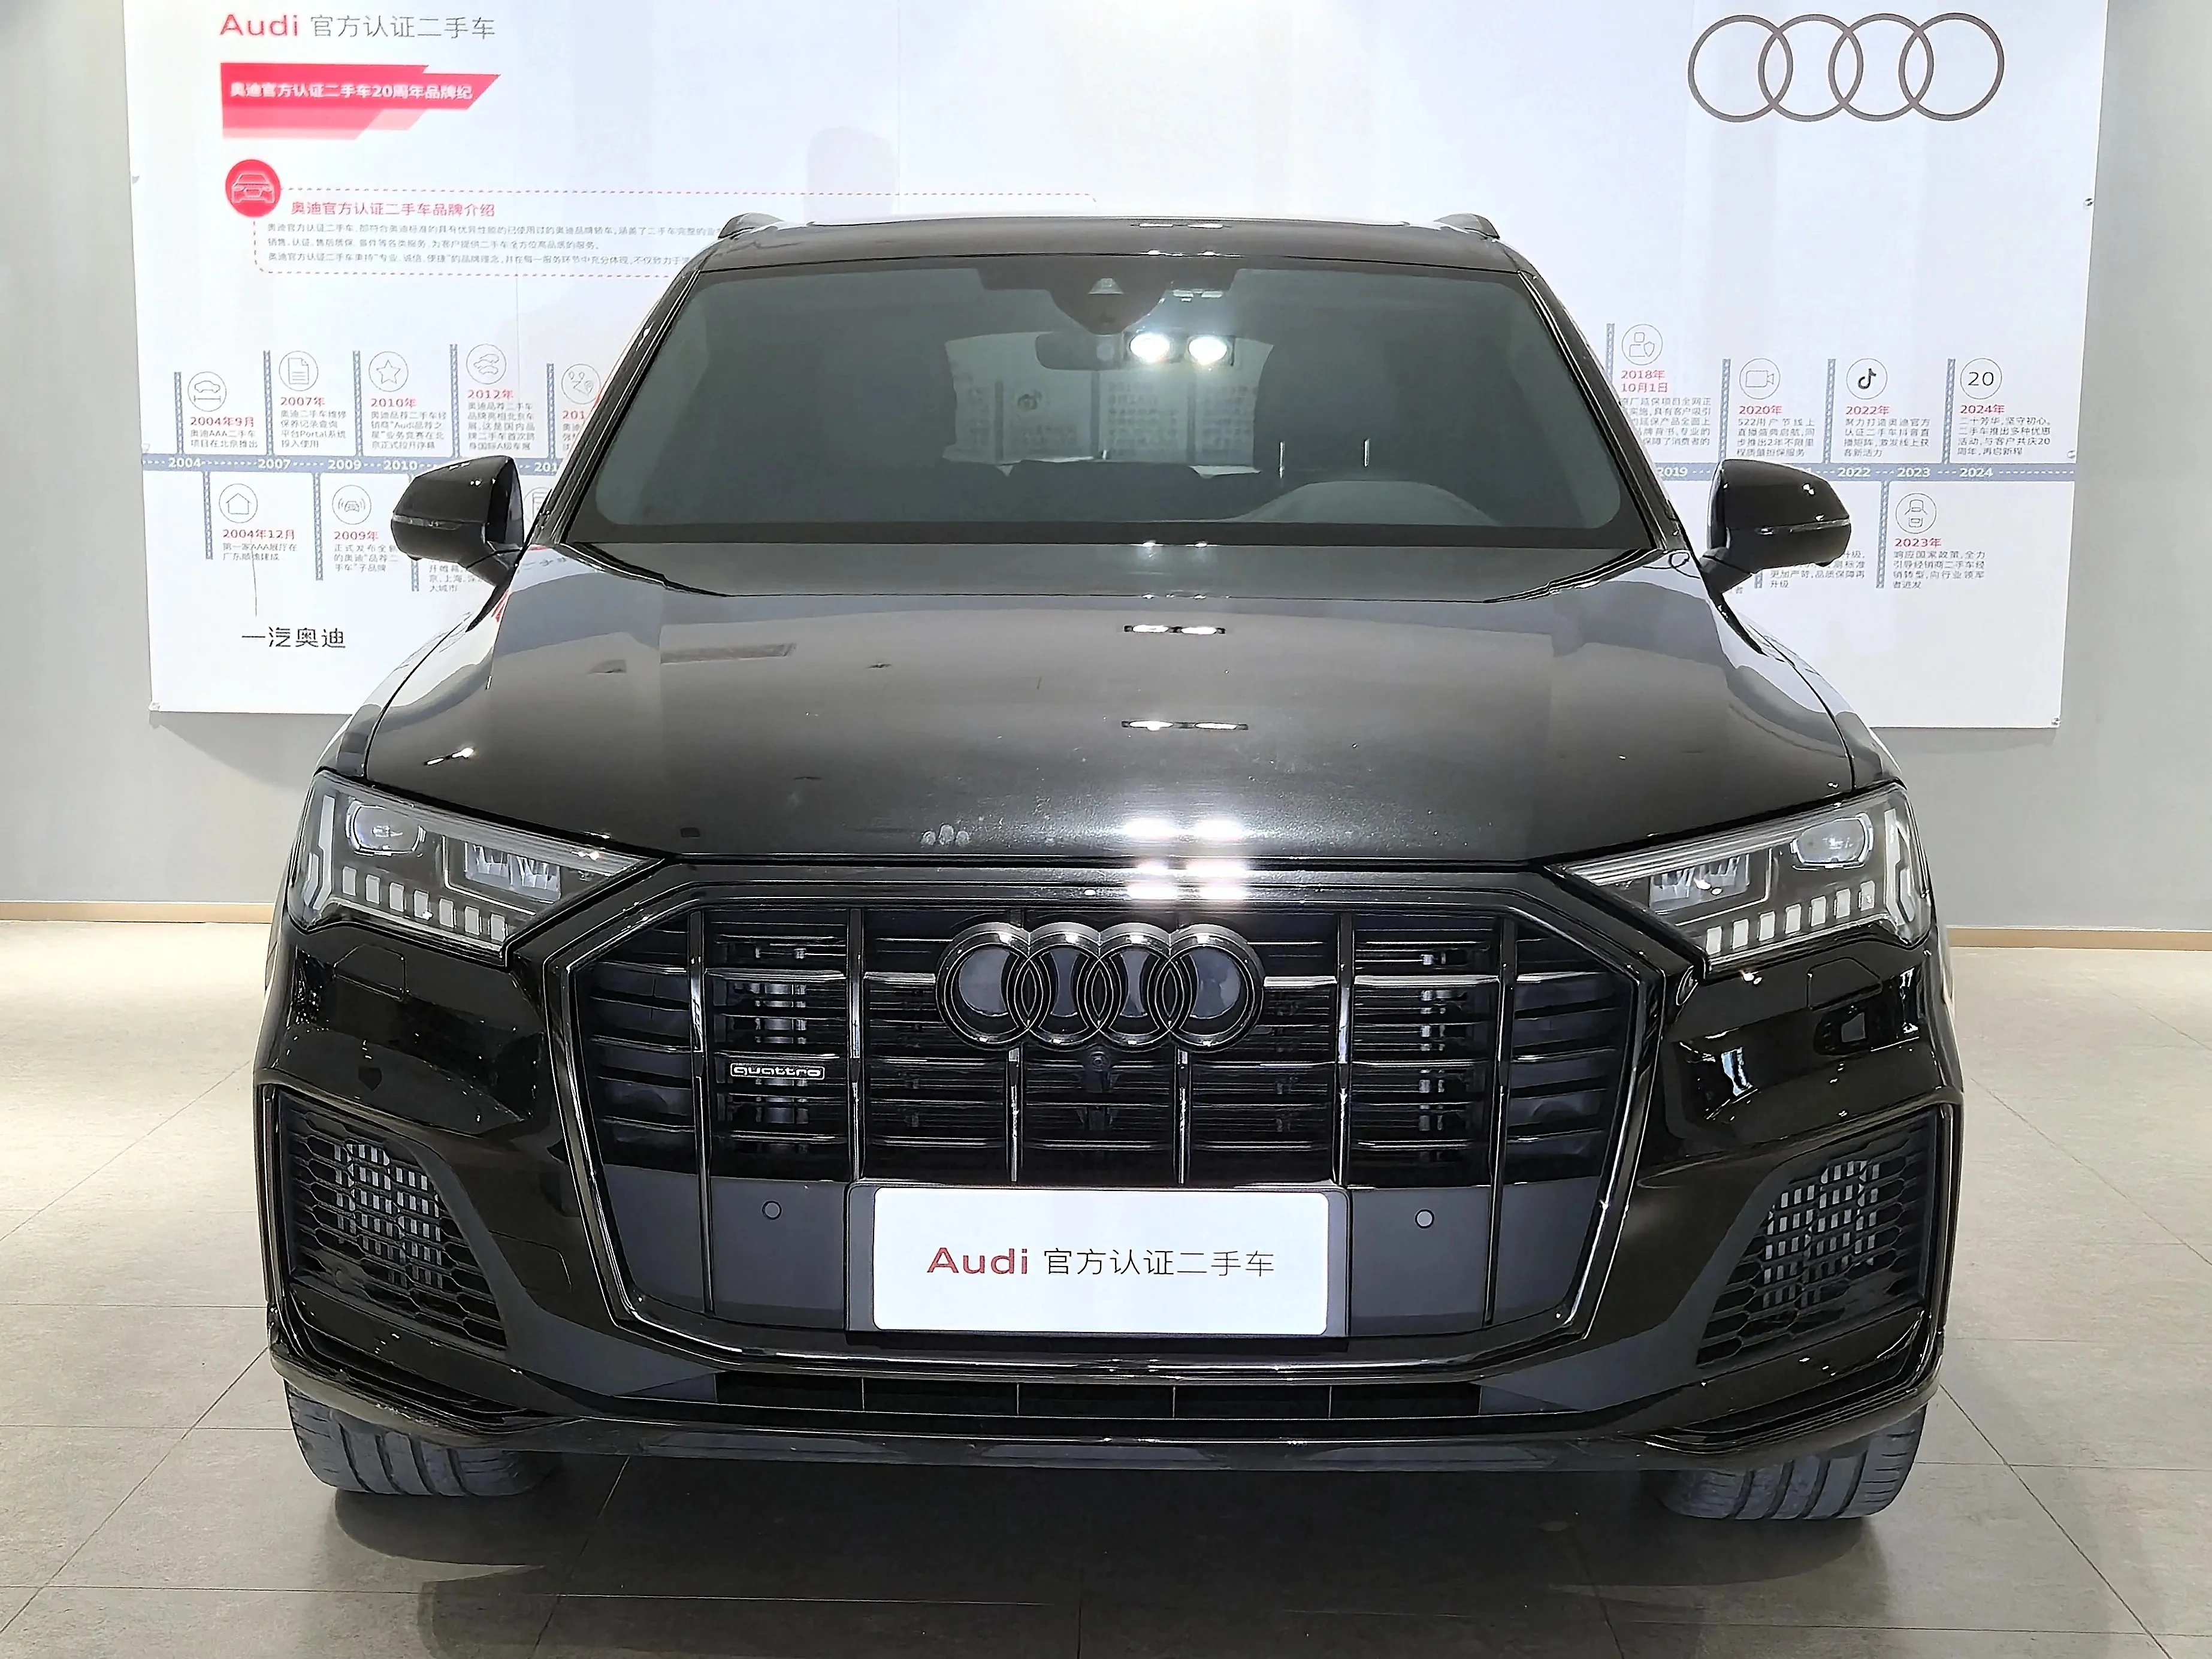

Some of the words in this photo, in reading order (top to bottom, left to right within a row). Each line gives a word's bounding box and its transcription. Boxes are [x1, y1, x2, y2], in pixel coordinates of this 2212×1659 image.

[219, 13, 298, 37] Audi
[310, 14, 495, 40] 官方认证二手车
[230, 82, 473, 100] 奥迪官方认证二手车20周年品牌纪
[291, 201, 495, 217] 奥迪官方认证二手车品牌介绍
[1621, 370, 1665, 379] 2018年
[1968, 371, 1994, 386] 20
[1622, 382, 1668, 393] 10月1日
[467, 389, 513, 400] 2012年
[280, 397, 325, 406] 2007年
[371, 398, 416, 408] 2010年
[1739, 405, 1782, 415] 2020年
[1845, 405, 1890, 415] 2022年
[1960, 404, 2005, 414] 2024年
[281, 410, 346, 419] 奥迪二手车维修
[562, 410, 584, 419] 201
[190, 416, 254, 427] 2004年9月
[280, 419, 337, 428] 保养记录查询
[1738, 418, 1815, 427] 522用户节线上
[1845, 418, 1930, 427] 聚力打造奥迪官方
[562, 423, 581, 432] 奥迪
[1959, 427, 2050, 436] 二手车推出多种优惠
[191, 430, 253, 438] 奥迪AAA二手车
[280, 430, 346, 439] 平台Portal系统
[1845, 428, 1929, 437] 认证二手车抖音直
[191, 439, 258, 448] 项目在北京推出
[282, 439, 319, 448] 投入使用
[372, 441, 435, 449] 京正式拉开序幕
[1737, 438, 1814, 447] 步推出2年不限里
[1737, 448, 1805, 457] 程质量担保服务
[1844, 448, 1882, 457] 客新活力
[168, 458, 201, 469] 2004
[258, 460, 291, 469] 2007
[328, 460, 362, 470] 2009
[383, 461, 418, 470] 2010
[534, 463, 558, 472] 201
[1657, 467, 1688, 477] 2019
[1837, 468, 1870, 478] 2022
[1897, 468, 1930, 478] 2023
[1959, 467, 1993, 478] 2024
[223, 528, 295, 540] 2004年12月
[334, 530, 378, 541] 2009年
[223, 542, 297, 552] 第一家AAA展厅在
[1894, 537, 1942, 548] 2023年
[334, 543, 398, 552] 正式发布全新
[223, 552, 280, 561] 广东顺德建成
[1893, 560, 1985, 569] 引导经销商二手车经
[430, 584, 458, 593] 大城市
[241, 626, 346, 649] 一汽奥迪
[733, 1066, 821, 1077] quattro
[926, 1247, 1028, 1275] Audi
[1044, 1247, 1274, 1277] 官方认证二手车
